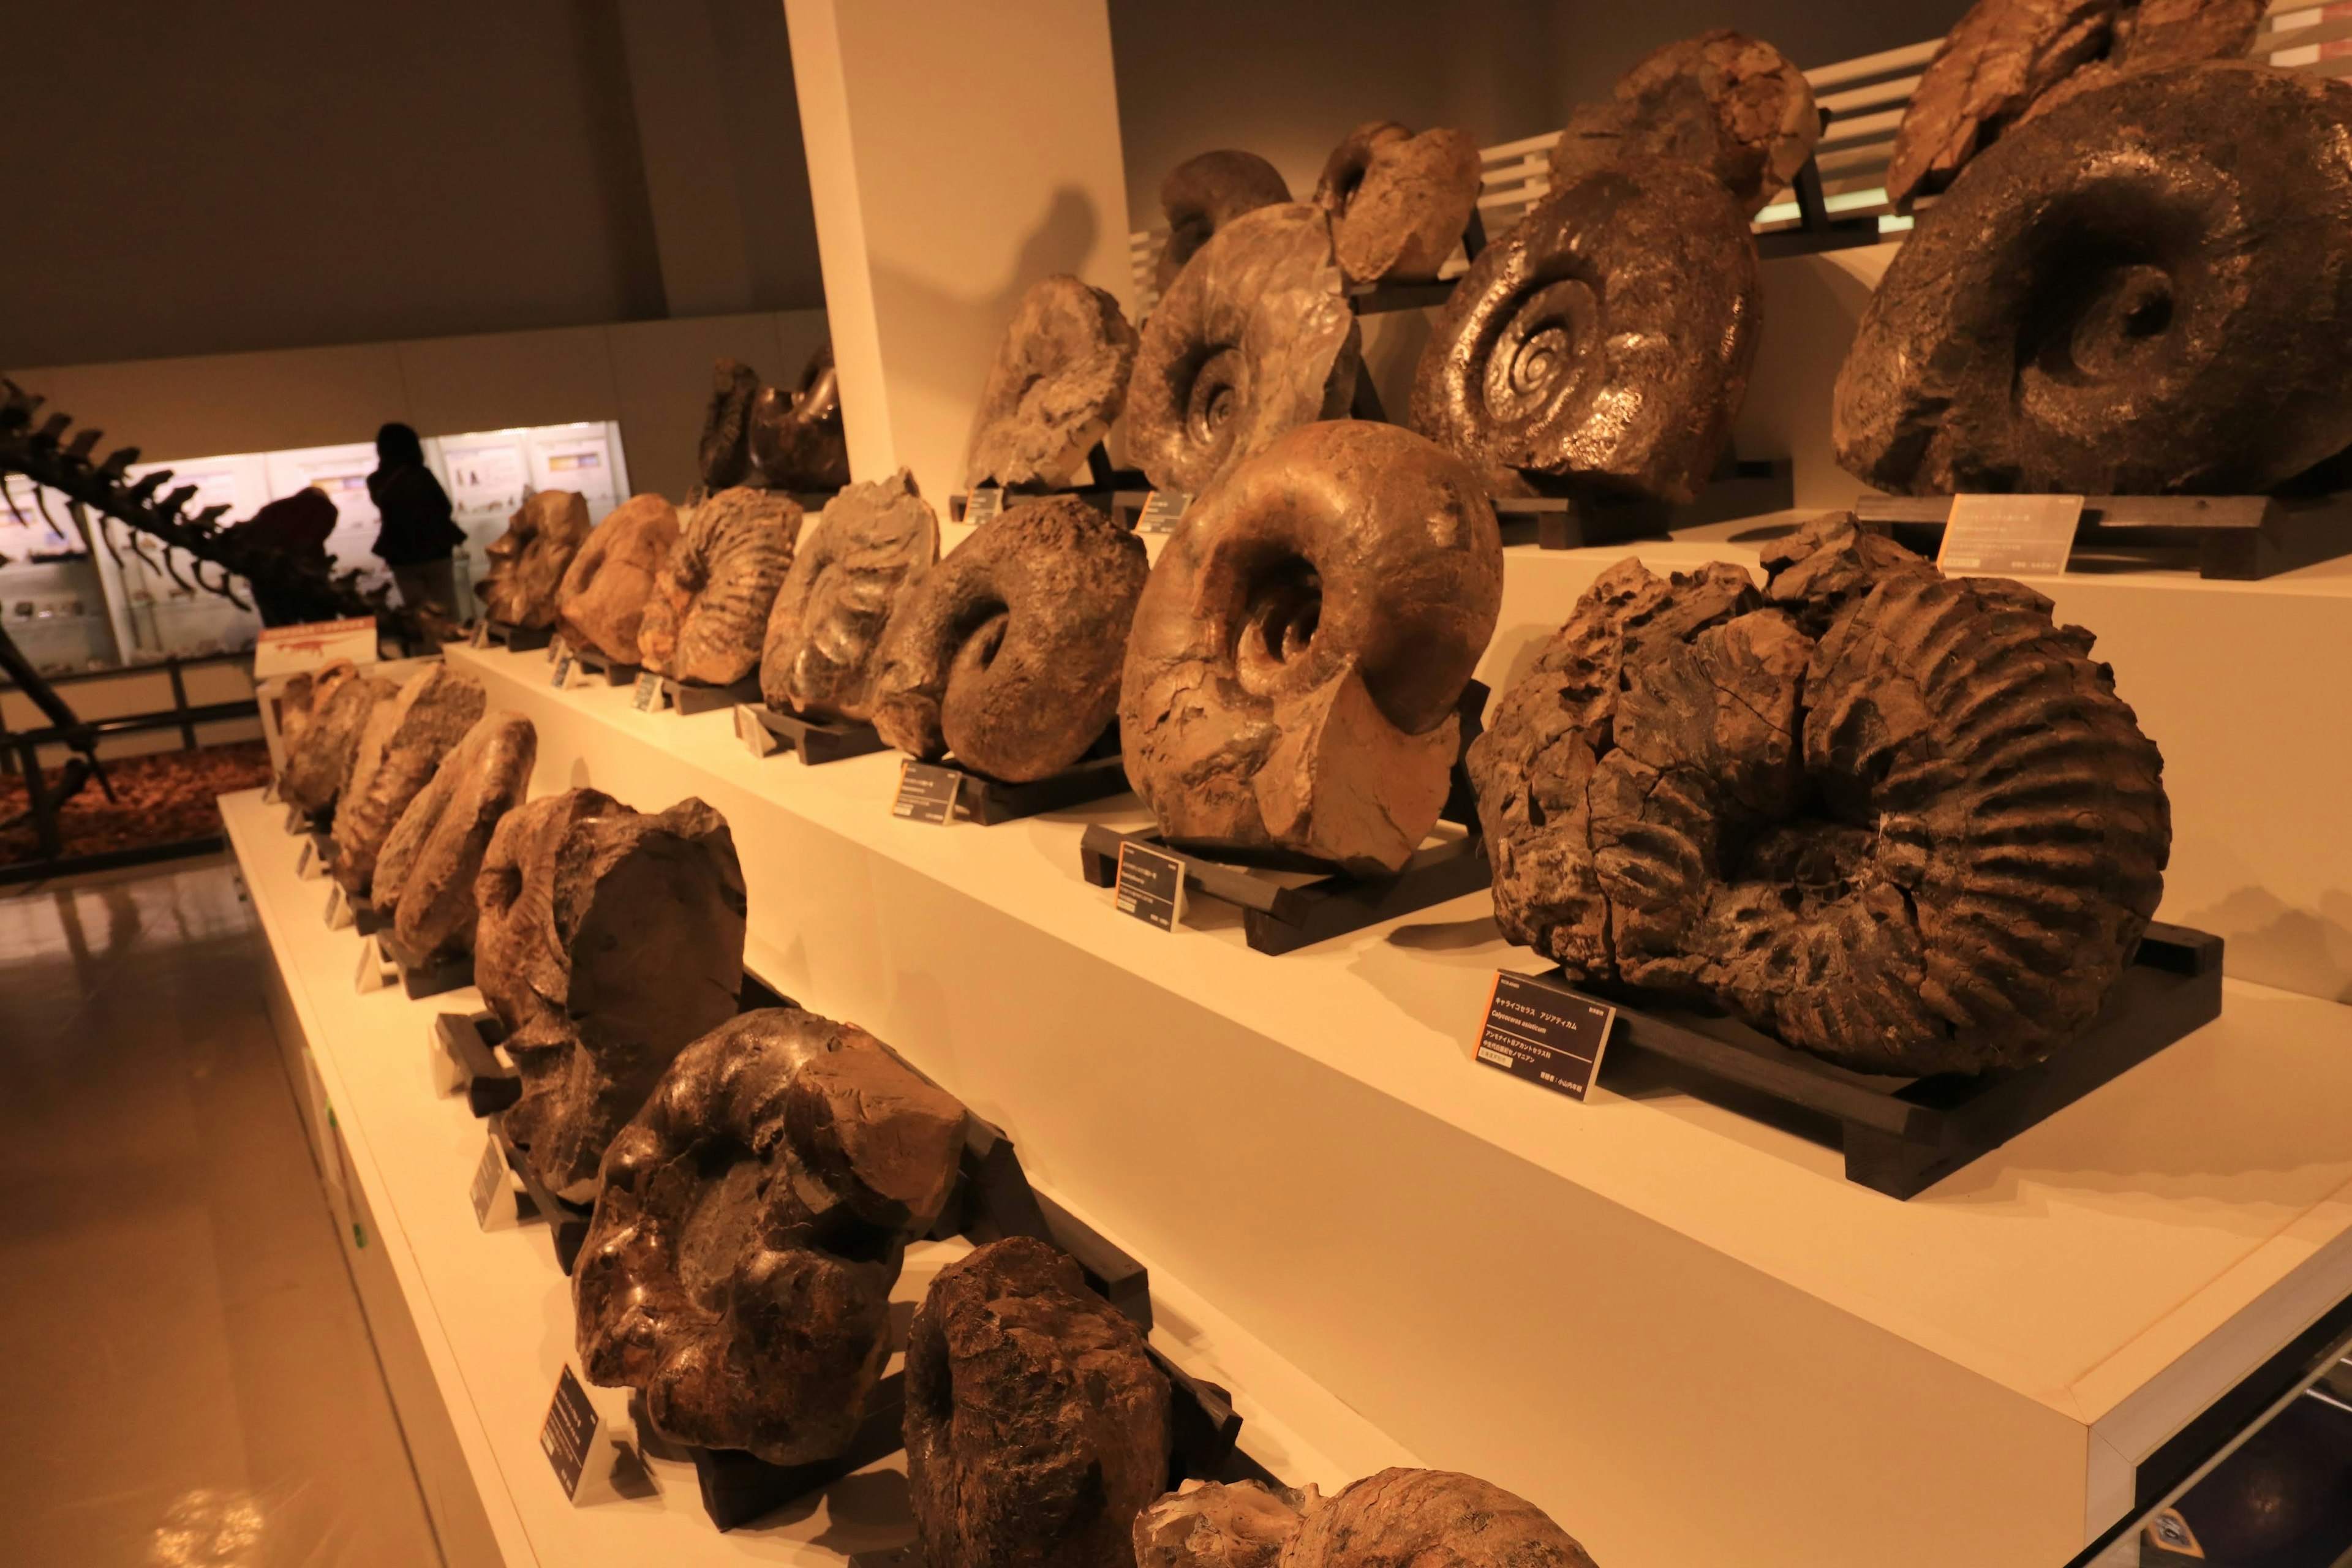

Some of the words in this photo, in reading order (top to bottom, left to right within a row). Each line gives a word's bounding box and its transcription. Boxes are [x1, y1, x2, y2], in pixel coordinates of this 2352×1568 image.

[1495, 997, 1536, 1017] キャライコセラス
[1539, 1011, 1577, 1030] アジアティカム
